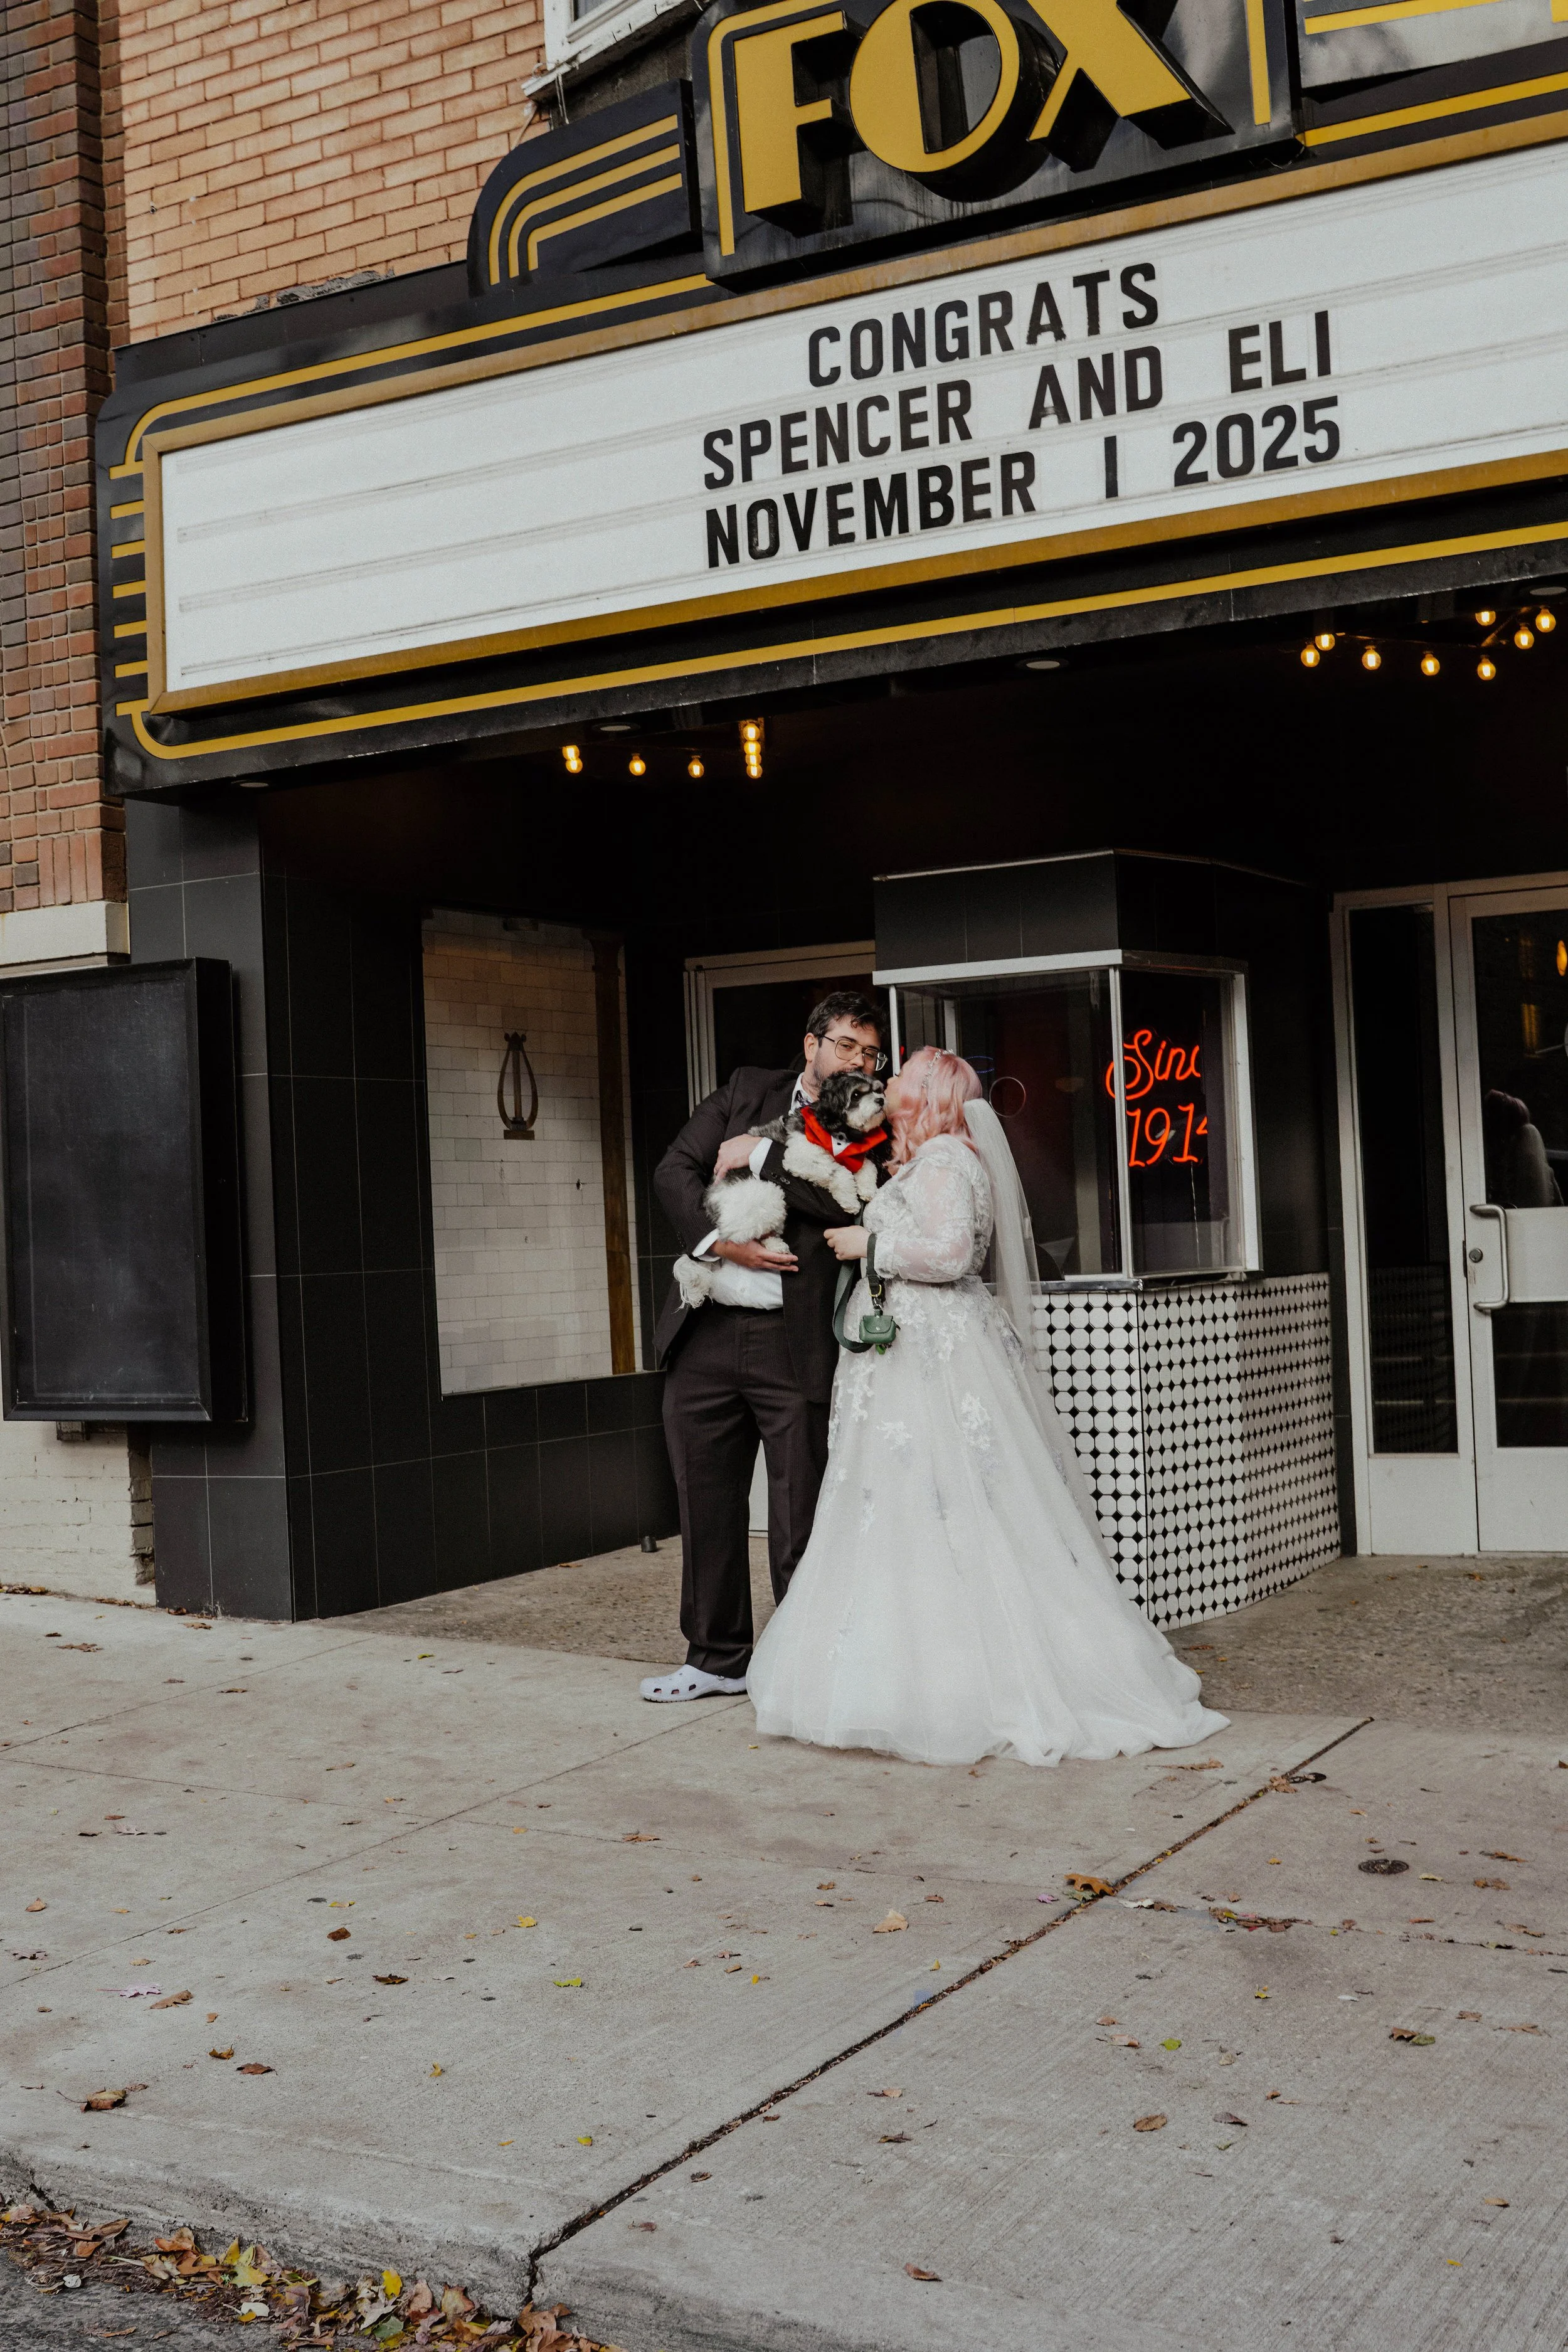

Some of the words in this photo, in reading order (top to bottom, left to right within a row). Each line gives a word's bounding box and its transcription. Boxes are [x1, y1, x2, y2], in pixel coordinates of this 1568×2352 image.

[734, 0, 1191, 213] FOX
[703, 379, 973, 490] SPENCER
[1029, 346, 1163, 430] AND
[1228, 310, 1332, 394] ELI
[809, 263, 1158, 388] CONGRATS
[706, 451, 1036, 568] NOVEMBER
[1173, 396, 1340, 487] 2025
